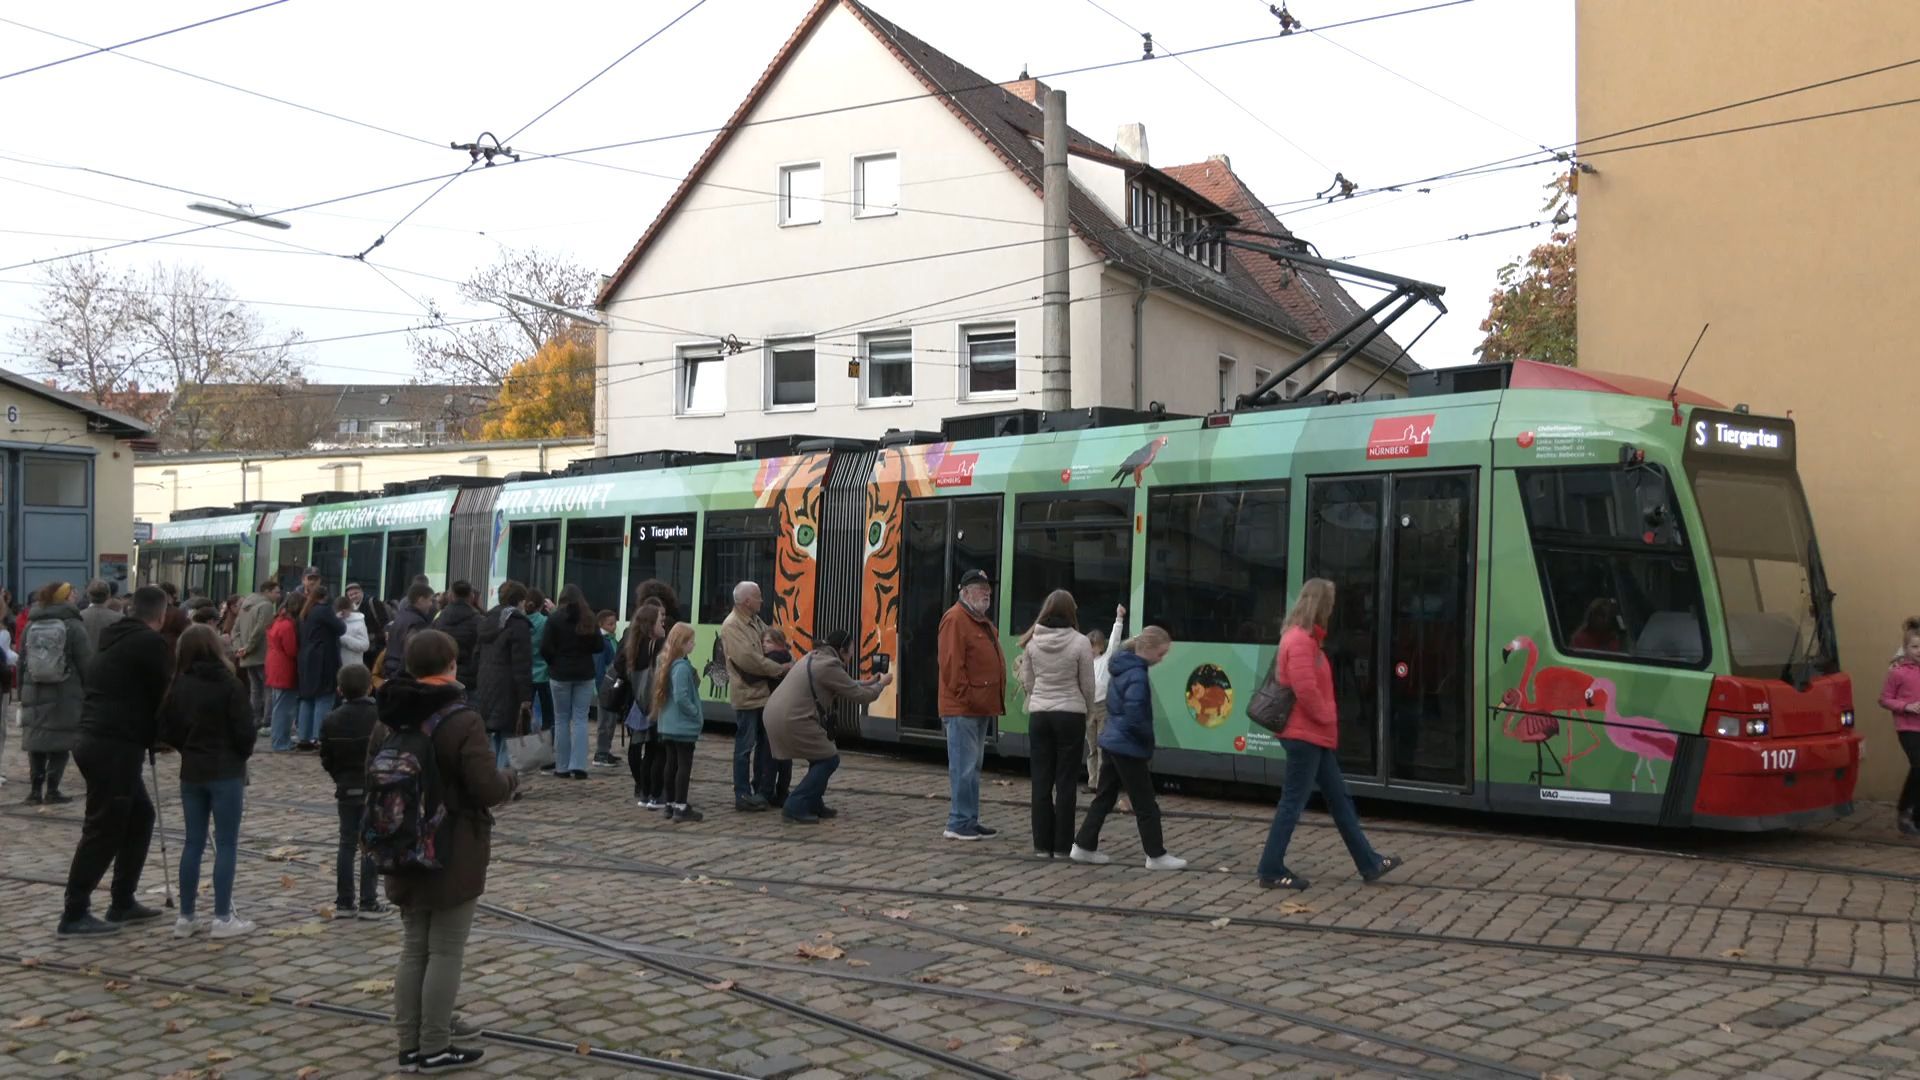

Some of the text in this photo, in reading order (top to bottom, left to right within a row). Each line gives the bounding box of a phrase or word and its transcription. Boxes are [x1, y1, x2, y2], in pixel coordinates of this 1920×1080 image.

[8, 406, 17, 422] 6
[1695, 421, 1778, 449] S Tiergarten
[1369, 445, 1409, 457] NÜRNBERG
[495, 482, 615, 515] WIR ZUKUNFT
[311, 506, 377, 532] GEMEINSAM
[376, 498, 447, 526] GESTALTEN
[640, 525, 688, 541] S Tiergarten
[1761, 749, 1797, 769] 1107
